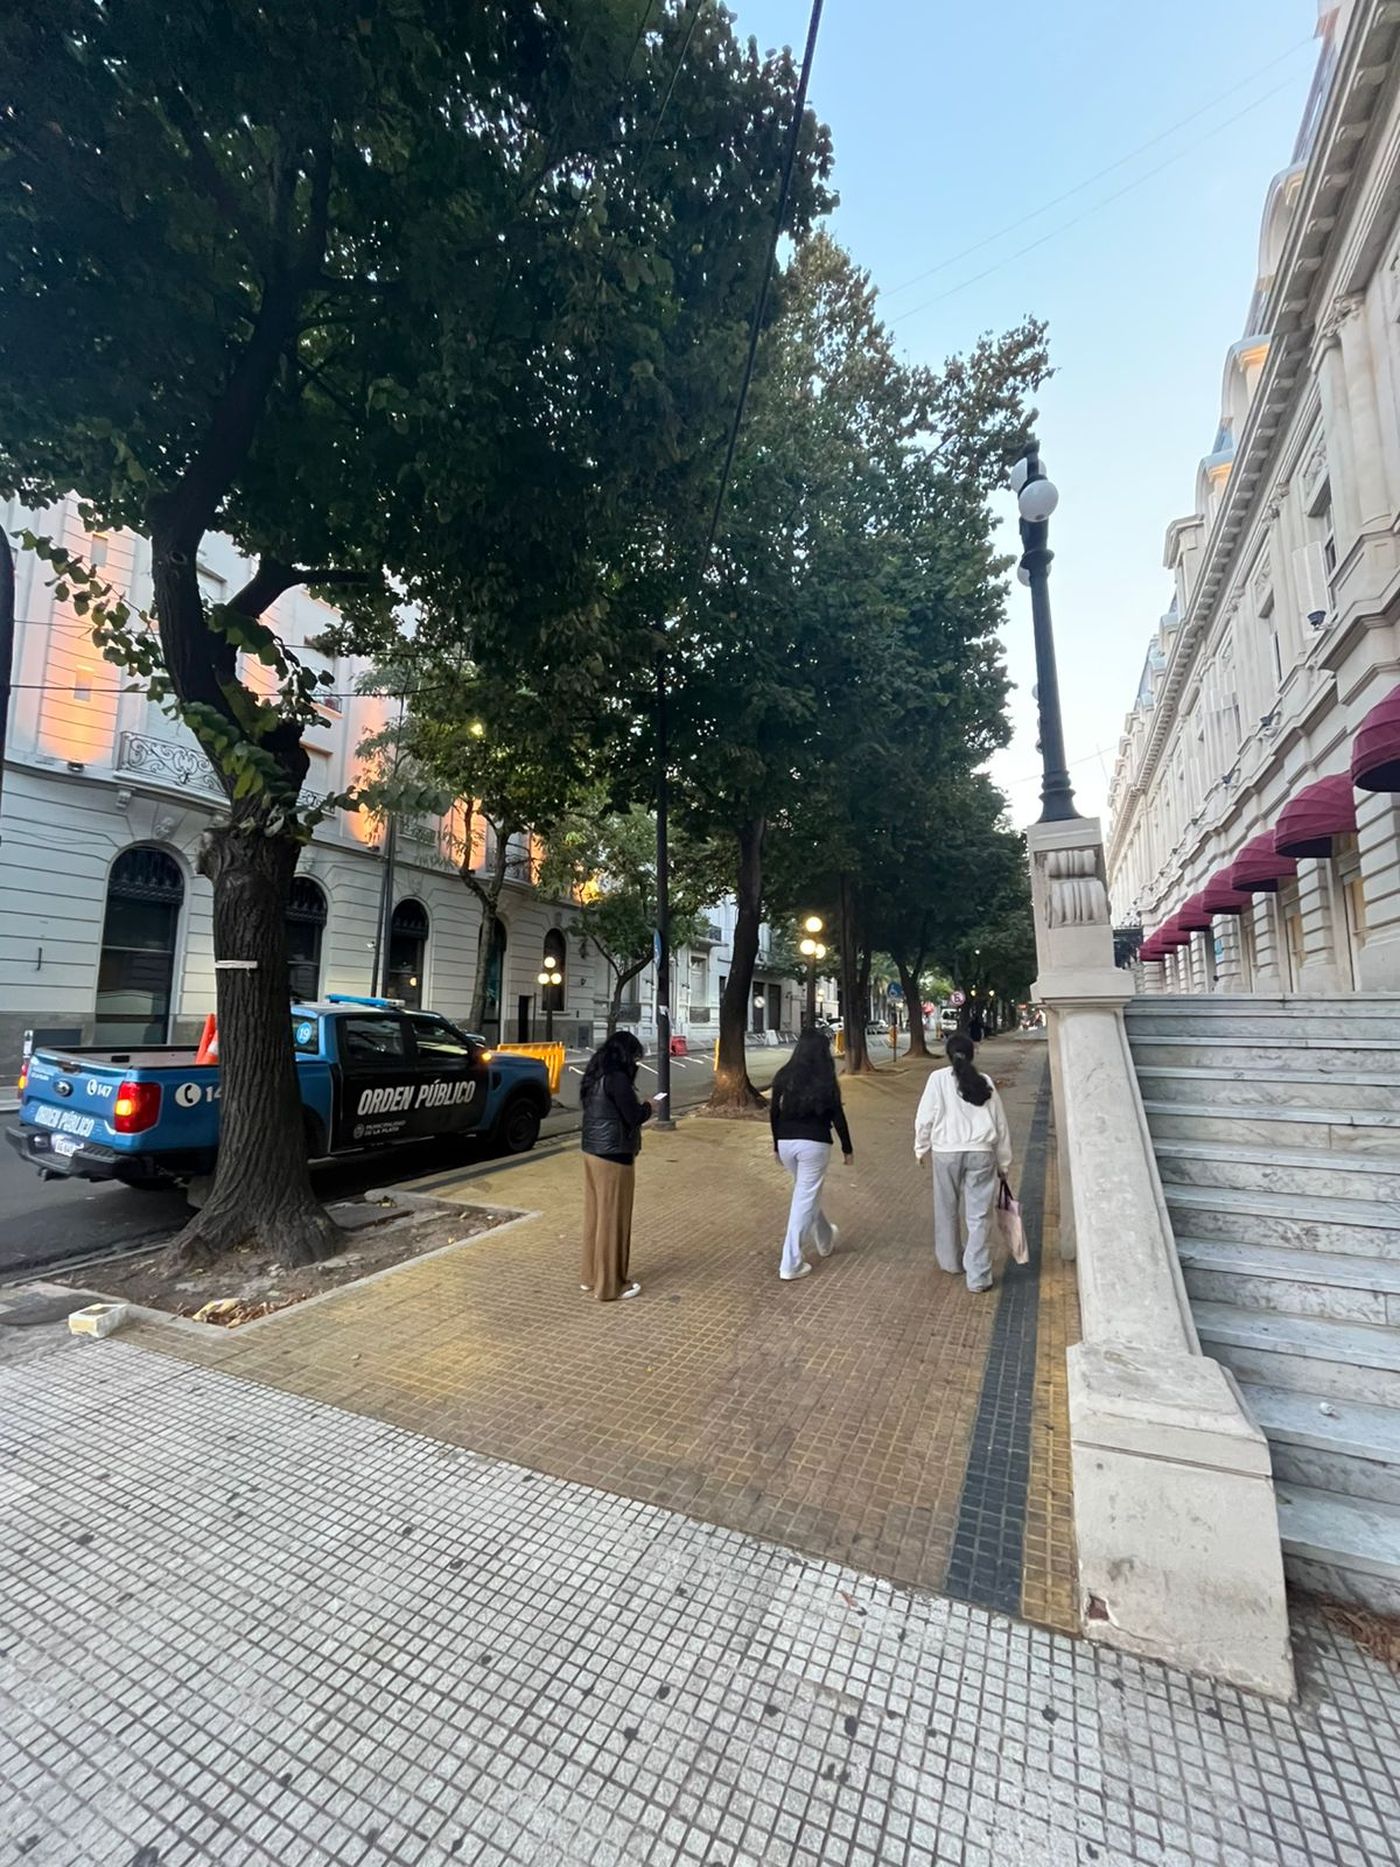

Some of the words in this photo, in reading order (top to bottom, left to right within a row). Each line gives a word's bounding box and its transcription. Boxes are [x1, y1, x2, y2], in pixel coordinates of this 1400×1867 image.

[97, 1083, 113, 1098] 147
[205, 1085, 222, 1103] 14
[357, 1085, 415, 1116] ORDEN
[414, 1078, 476, 1109] PÚBLICO
